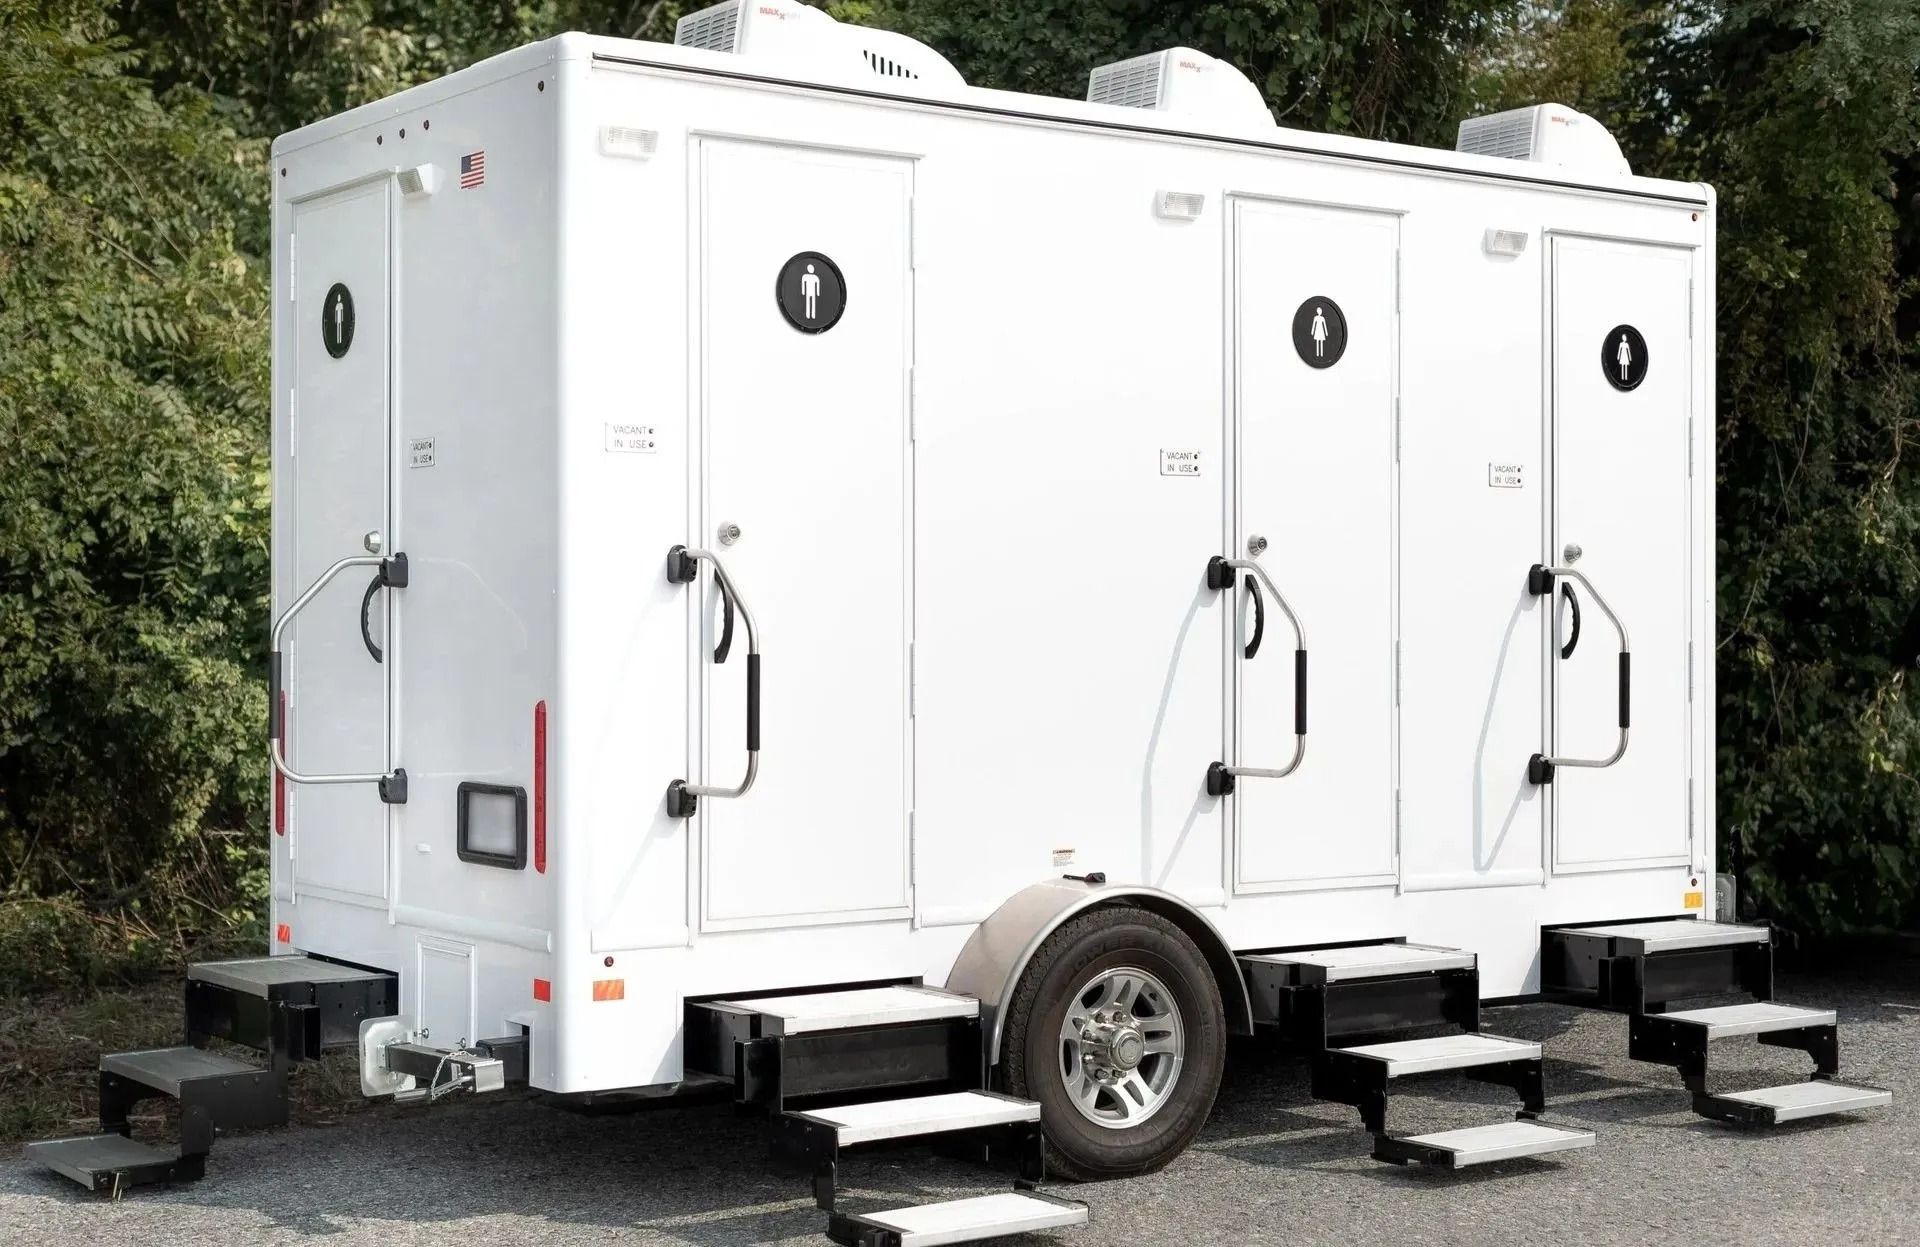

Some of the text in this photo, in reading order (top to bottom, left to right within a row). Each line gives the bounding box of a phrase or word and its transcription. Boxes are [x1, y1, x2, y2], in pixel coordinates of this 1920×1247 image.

[613, 424, 647, 434] VACANT
[413, 441, 428, 451] VACANT
[614, 439, 647, 448] IN USE
[420, 455, 428, 463] USE
[1167, 452, 1192, 460] VACANT
[1168, 464, 1192, 472] IN USE
[1495, 476, 1516, 485] IN USE
